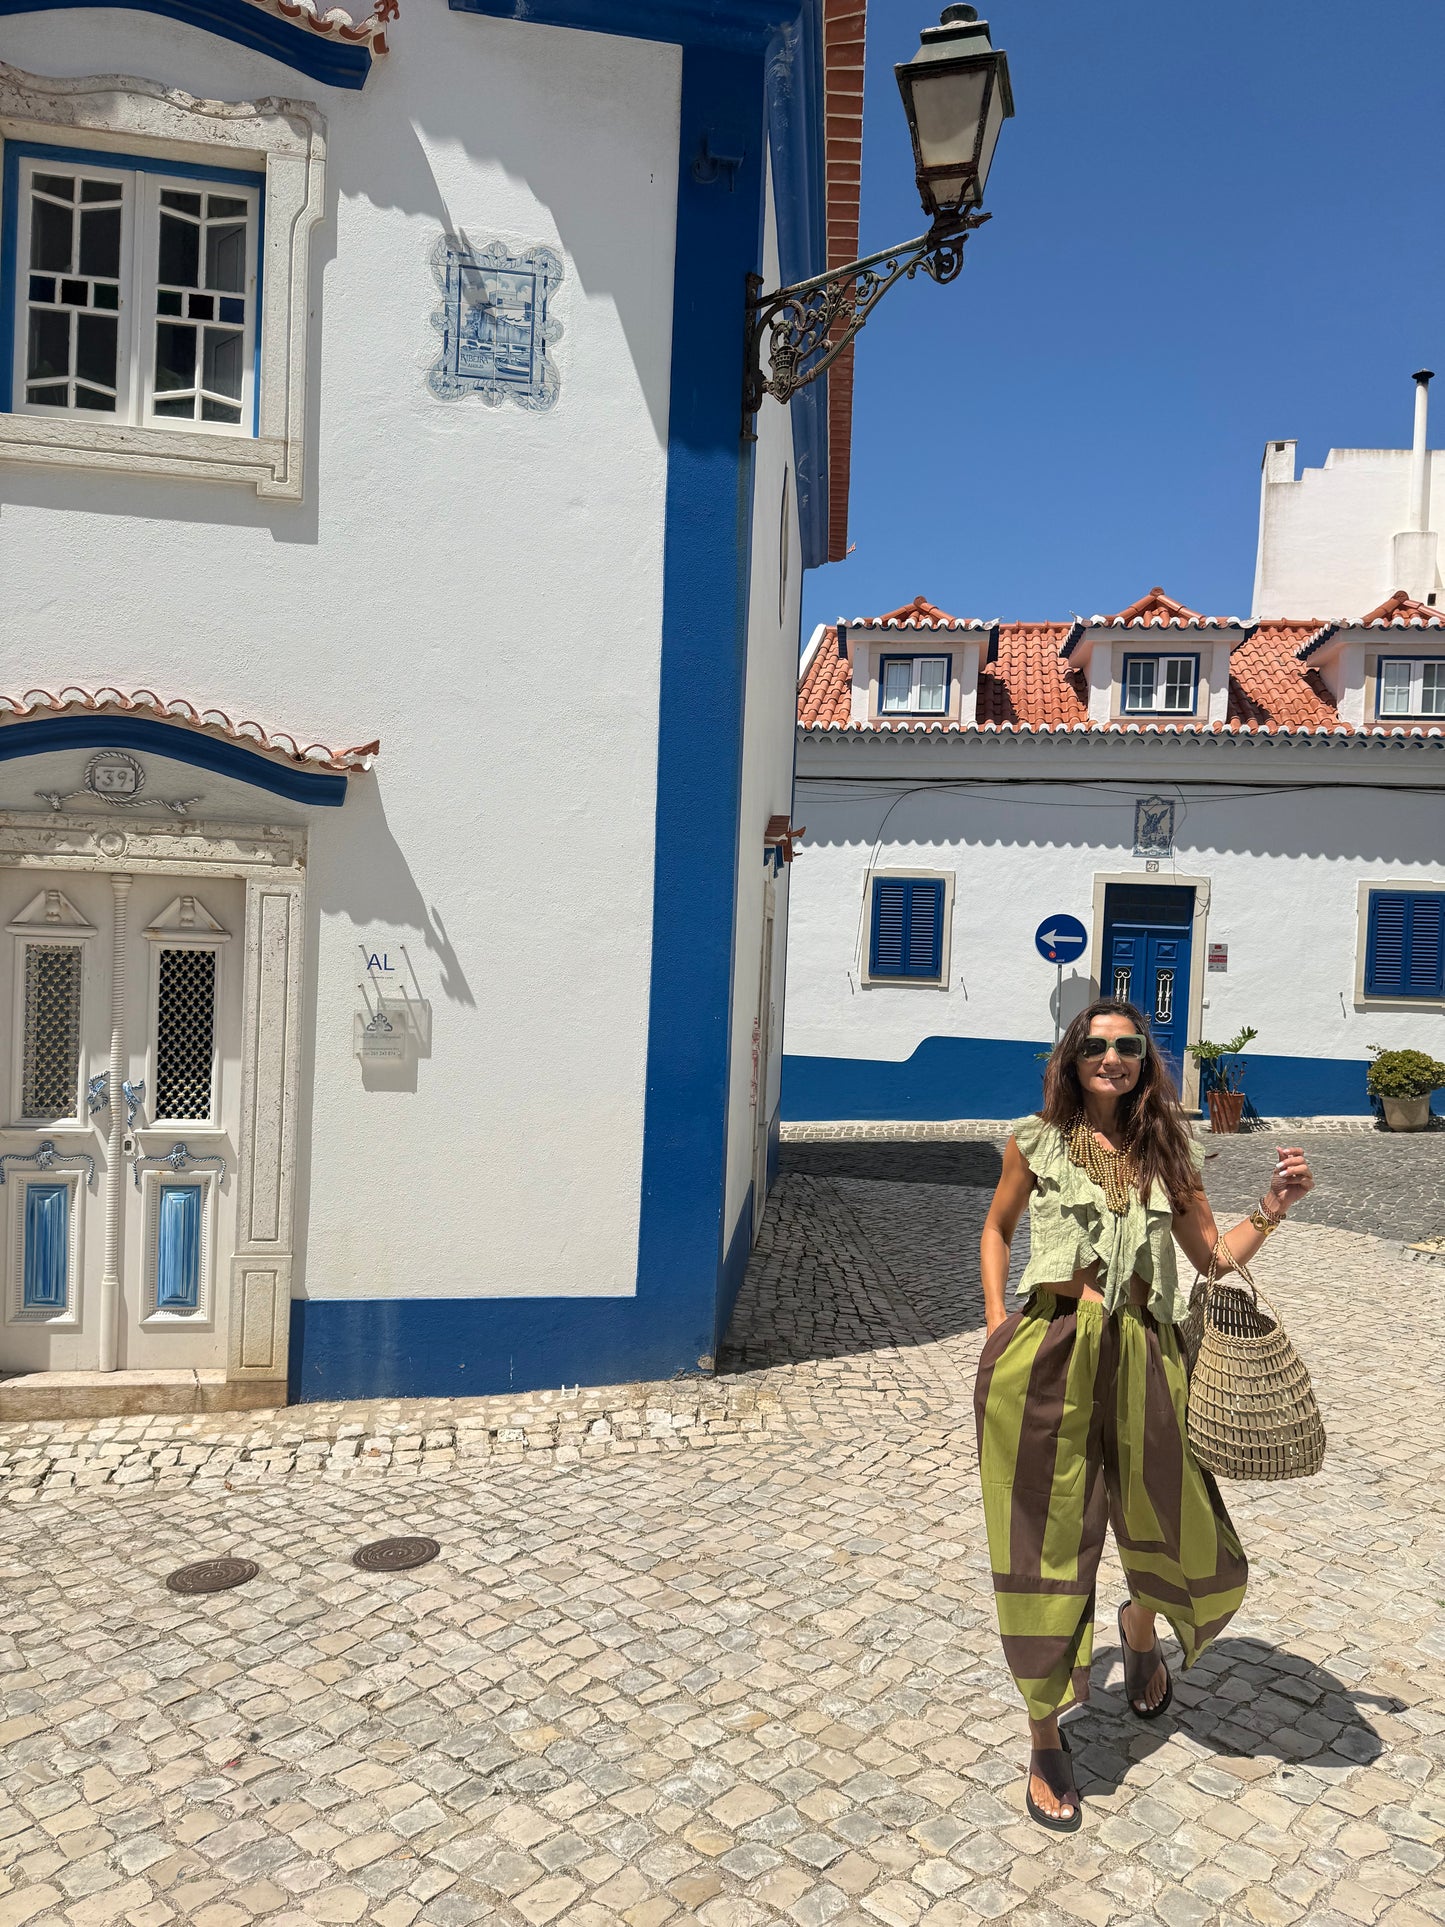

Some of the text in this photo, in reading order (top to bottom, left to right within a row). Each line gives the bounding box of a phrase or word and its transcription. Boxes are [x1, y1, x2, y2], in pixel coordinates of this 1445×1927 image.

[460, 353, 489, 365] RIBEIRA
[101, 769, 128, 788] 39
[366, 953, 395, 971] AL
